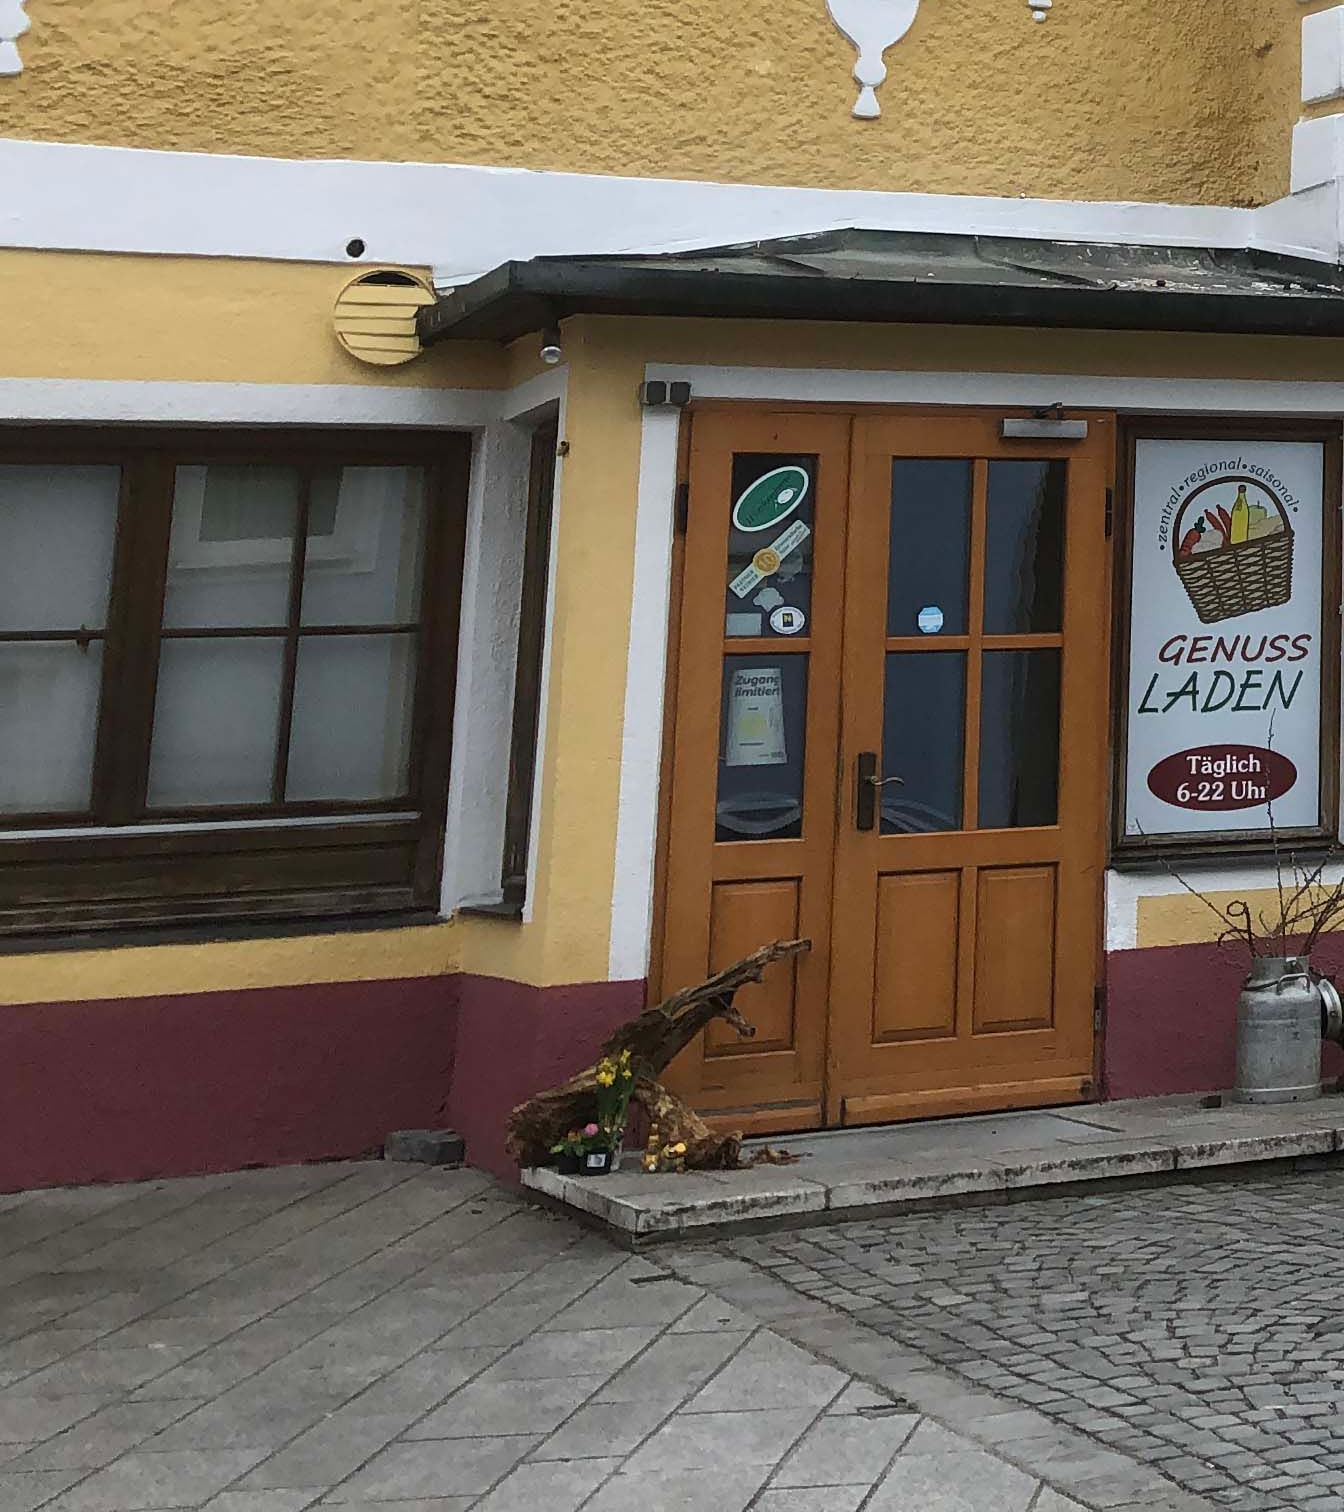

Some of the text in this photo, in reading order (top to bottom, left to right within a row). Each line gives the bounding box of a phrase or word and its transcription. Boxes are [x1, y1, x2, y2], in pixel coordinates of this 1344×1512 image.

[1158, 457, 1300, 542] zentral regional saisonal
[1158, 634, 1313, 666] GENUSS
[1137, 670, 1304, 714] LADEN
[1186, 754, 1262, 778] Täglich
[1177, 781, 1224, 802] 6-22
